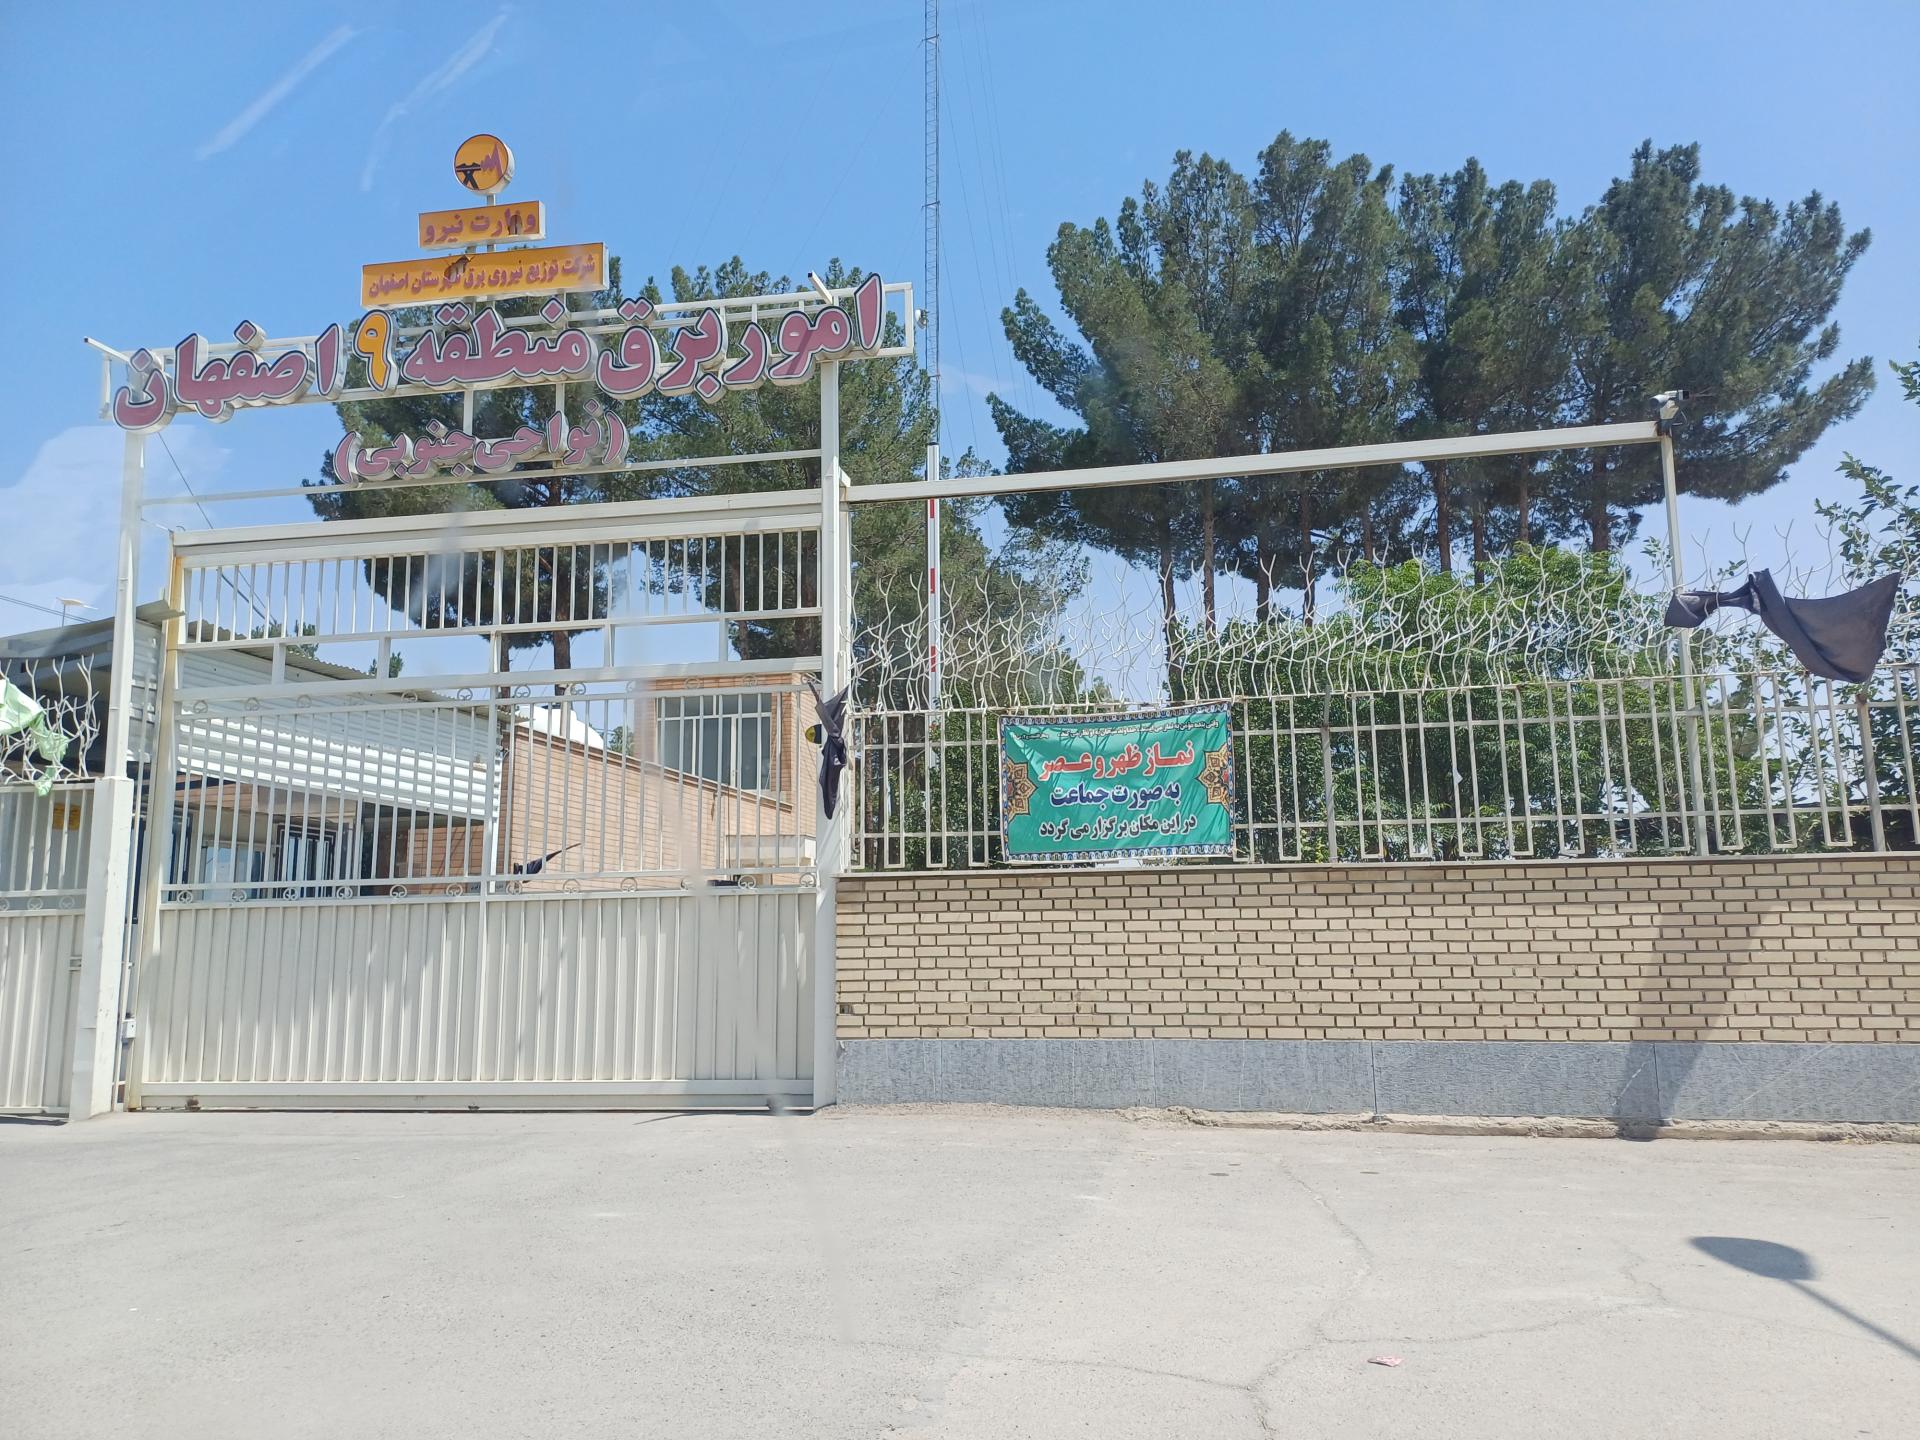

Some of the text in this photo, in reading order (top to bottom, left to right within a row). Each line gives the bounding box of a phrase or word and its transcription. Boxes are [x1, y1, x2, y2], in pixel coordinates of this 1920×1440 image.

[423, 207, 536, 243] وارت نیرو
[463, 268, 485, 289] برق
[488, 259, 523, 287] نیروی
[526, 259, 559, 284] توزیع
[561, 254, 595, 280] شرکت
[368, 272, 409, 298] اصفهان
[113, 273, 883, 431] امور برق منطقه ۹ اصفهان
[1039, 741, 1194, 781] نماز ظهر و عصر
[1051, 781, 1181, 811] به صورت جماعت
[1129, 814, 1159, 838] مکان
[1160, 812, 1180, 835] این
[1182, 815, 1197, 834] در
